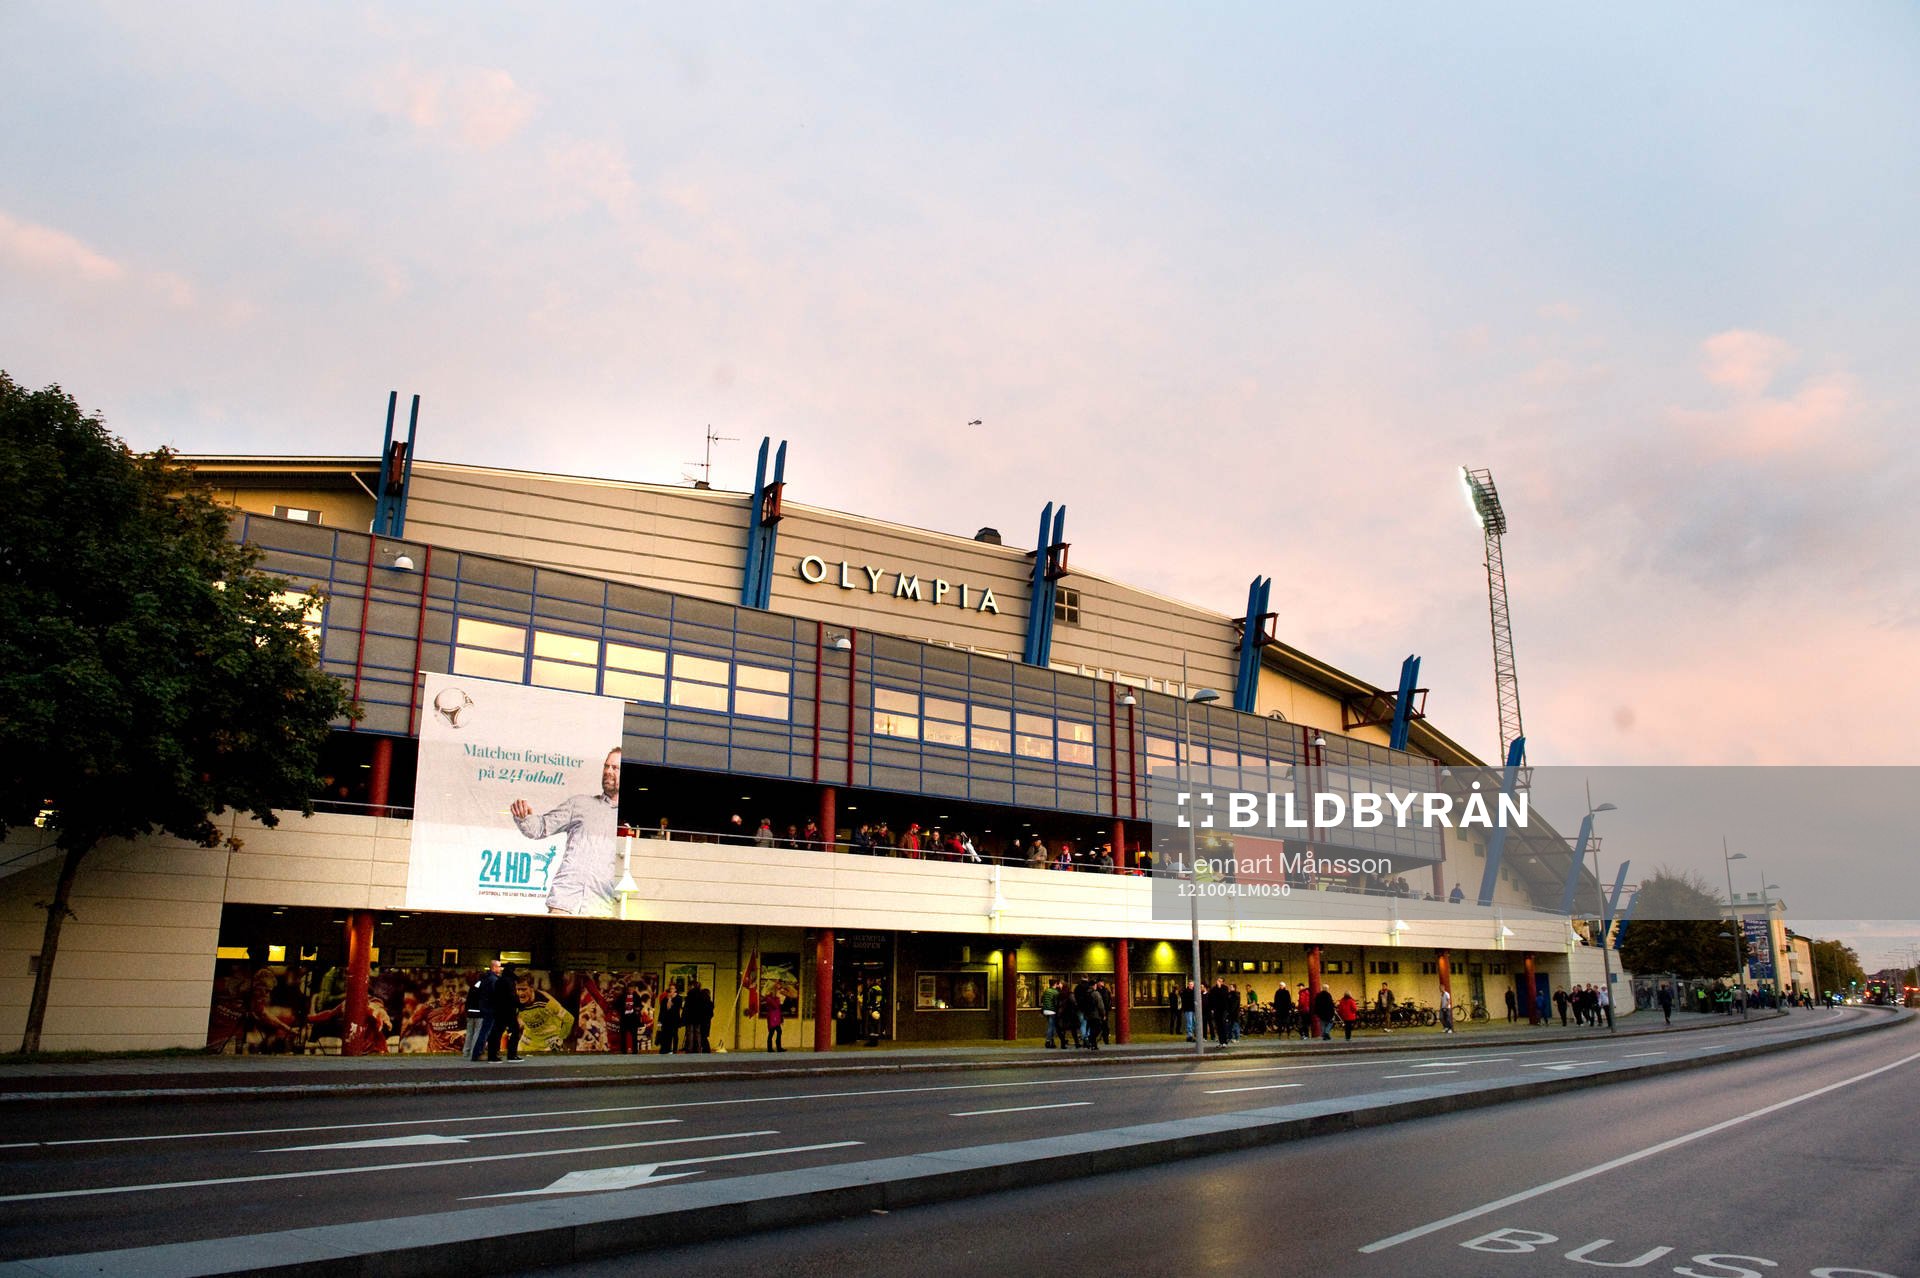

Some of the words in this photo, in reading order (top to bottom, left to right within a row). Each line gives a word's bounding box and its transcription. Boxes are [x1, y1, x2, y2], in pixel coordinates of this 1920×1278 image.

[800, 555, 999, 614] OLYMPIA
[463, 743, 521, 761] Matchen
[525, 750, 584, 768] fortsätter
[478, 765, 495, 781] på
[479, 849, 502, 882] 24
[504, 851, 532, 884] HD
